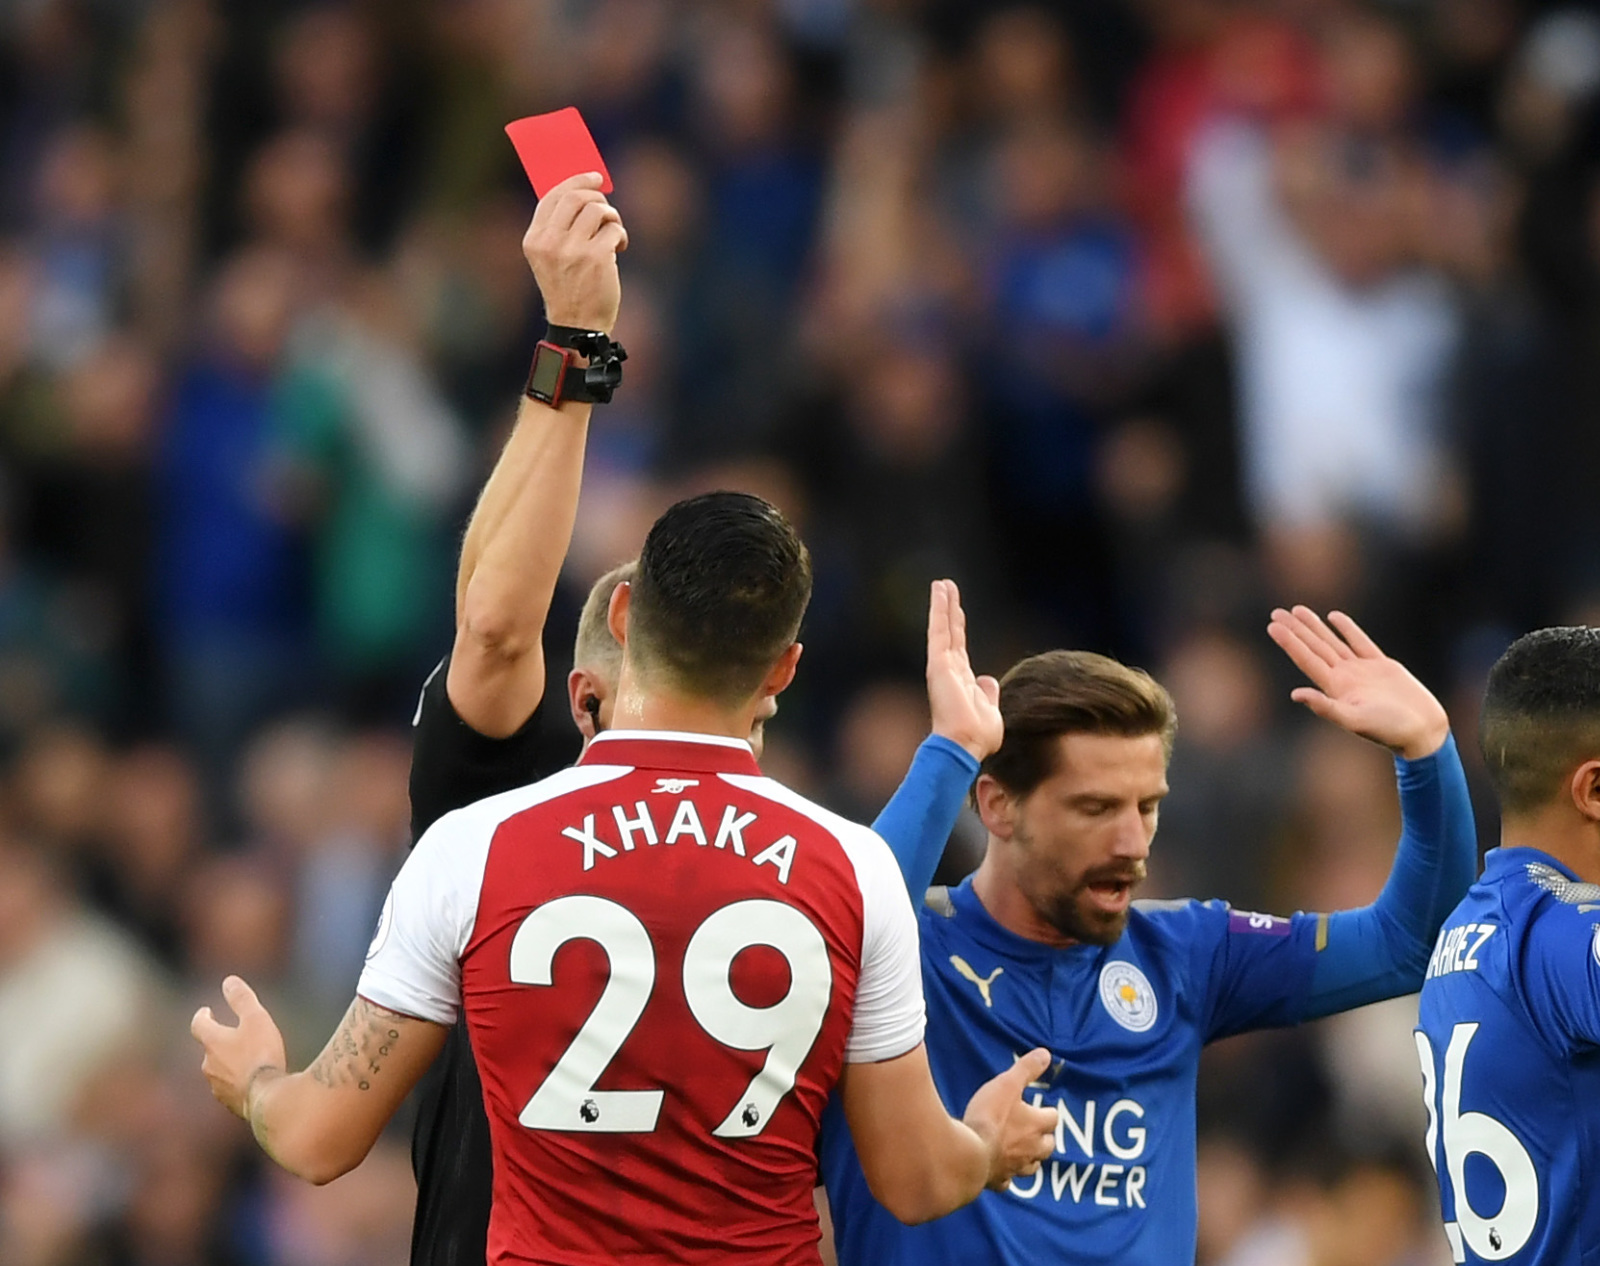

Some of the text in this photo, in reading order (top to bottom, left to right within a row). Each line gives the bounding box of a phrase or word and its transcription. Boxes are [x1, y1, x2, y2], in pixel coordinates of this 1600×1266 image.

[561, 800, 798, 885] XHAKA
[1425, 923, 1497, 981] AHREZ
[509, 894, 833, 1138] 29
[1033, 1092, 1147, 1161] NG
[1008, 1160, 1148, 1209] OWER
